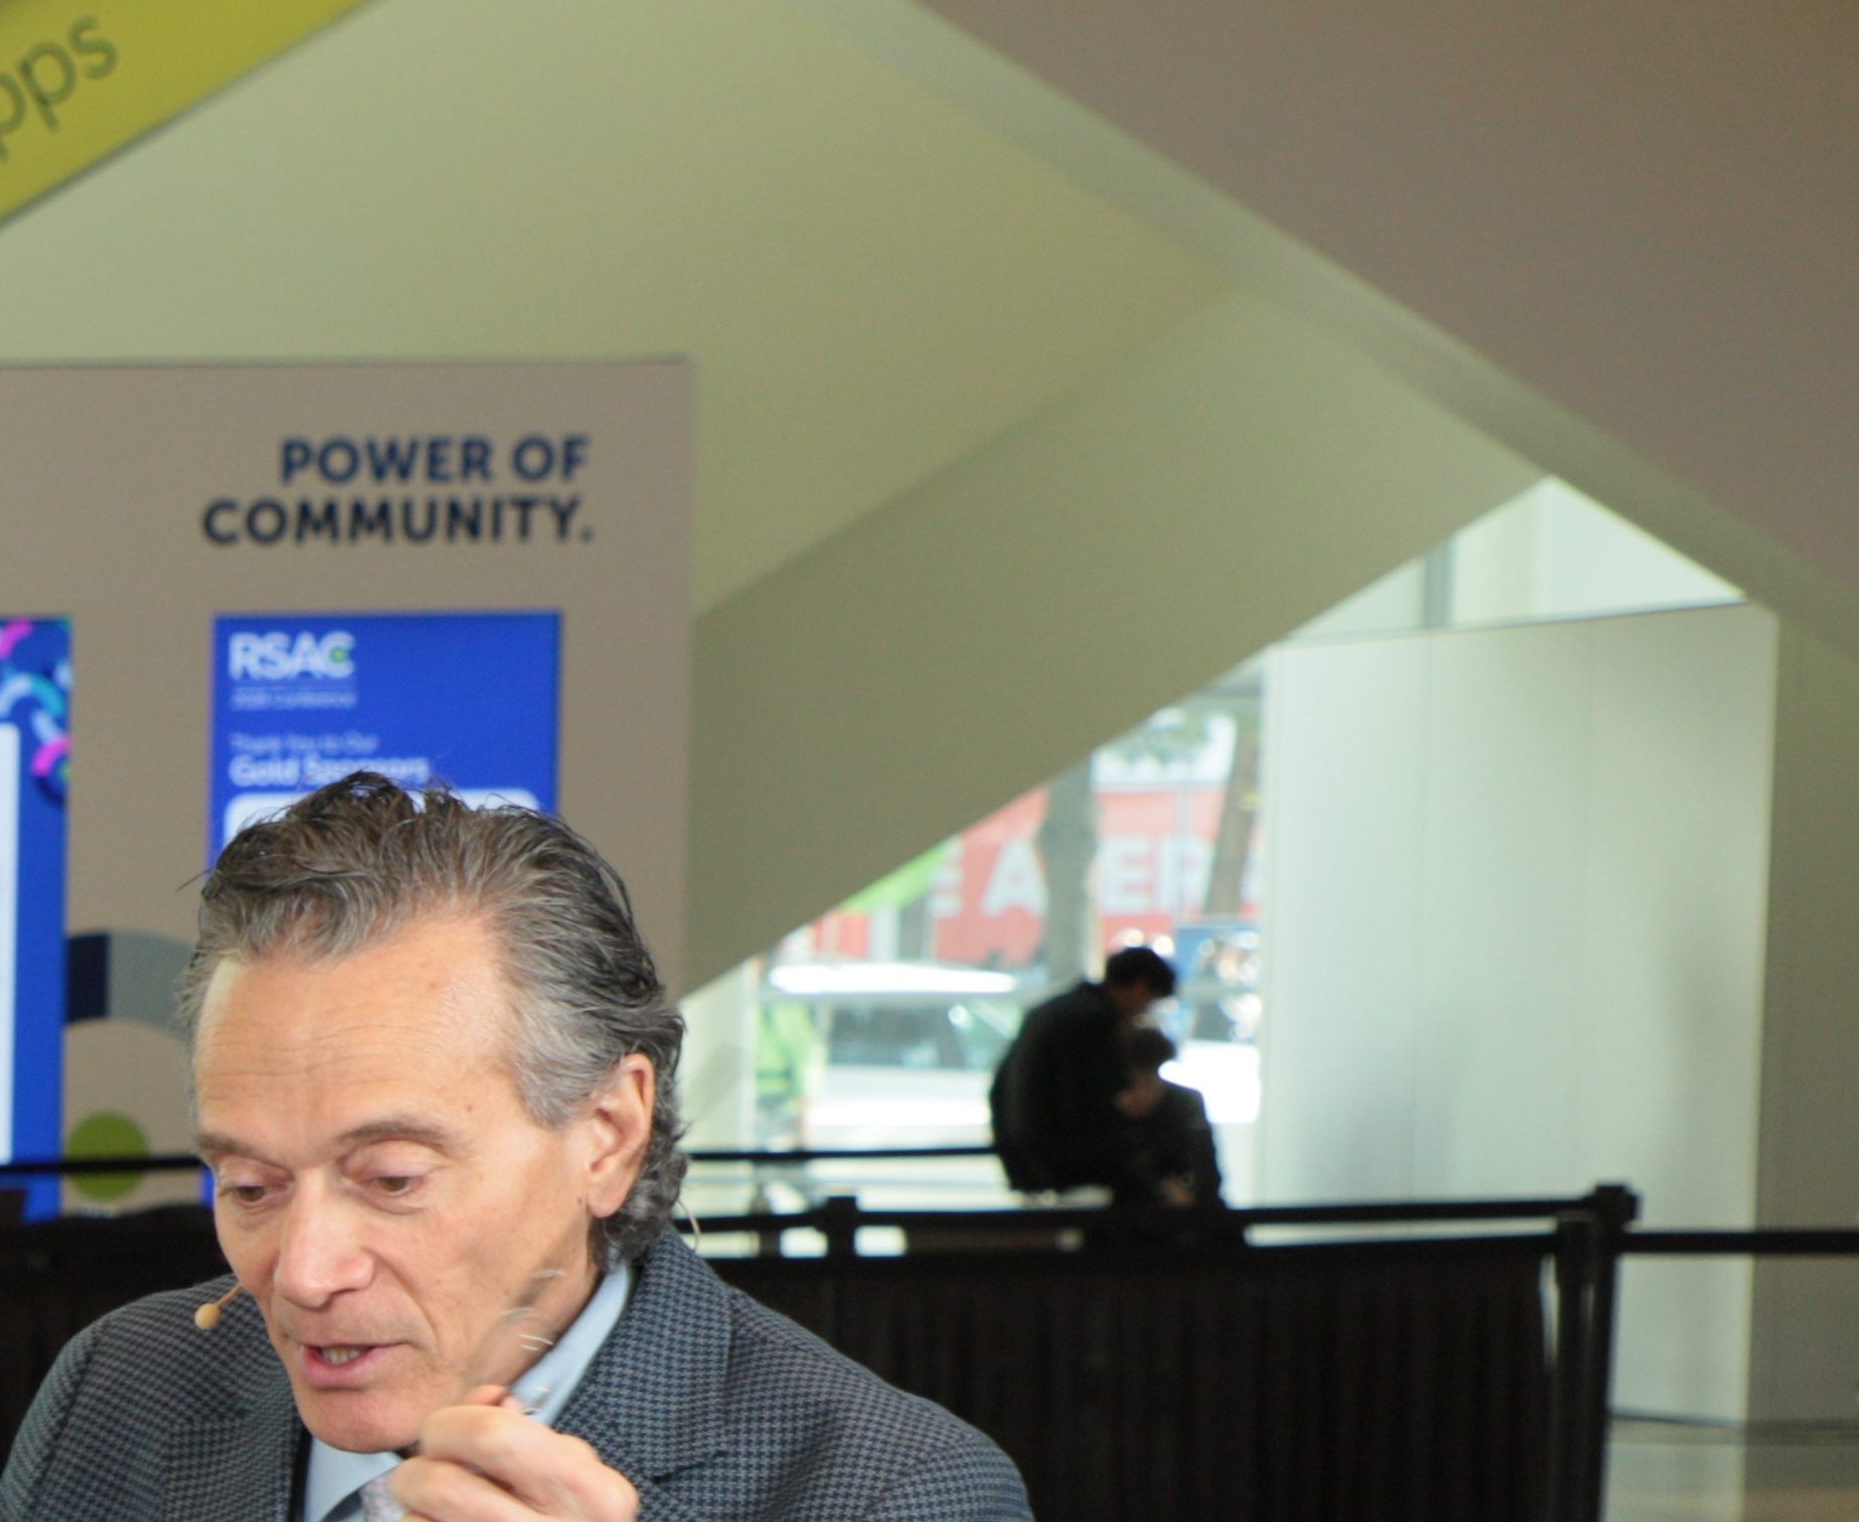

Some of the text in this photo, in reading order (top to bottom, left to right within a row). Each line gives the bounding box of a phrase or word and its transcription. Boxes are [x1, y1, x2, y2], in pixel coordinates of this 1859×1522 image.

[280, 436, 592, 484] POWER OF
[202, 496, 595, 545] COMMUNITY.
[229, 631, 355, 679] RSAC
[229, 756, 301, 786] Gold
